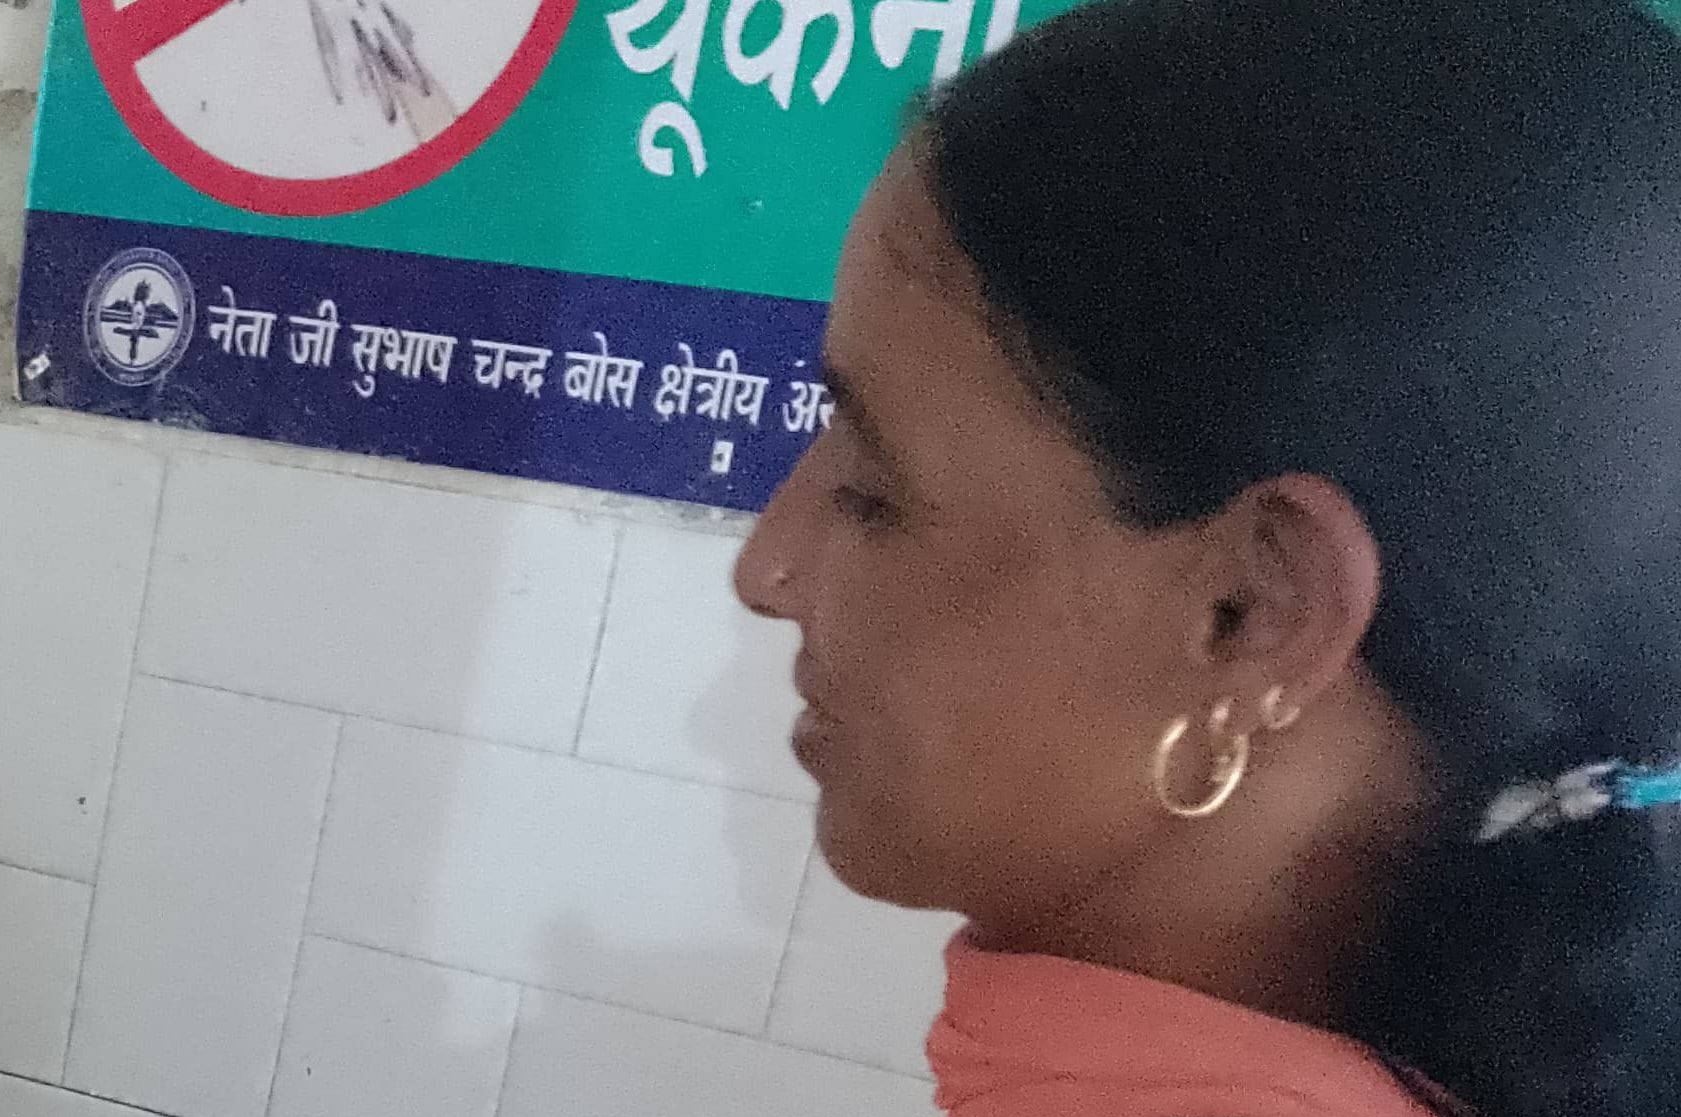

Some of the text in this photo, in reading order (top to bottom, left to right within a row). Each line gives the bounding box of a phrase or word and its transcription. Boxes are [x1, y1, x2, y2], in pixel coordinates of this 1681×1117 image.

[208, 285, 277, 357] नेता
[289, 299, 340, 367] जी
[350, 324, 458, 397] सुभाष
[471, 339, 553, 400] चन्द्र
[564, 331, 644, 408] बोस
[654, 342, 769, 425] क्षेत्रीय
